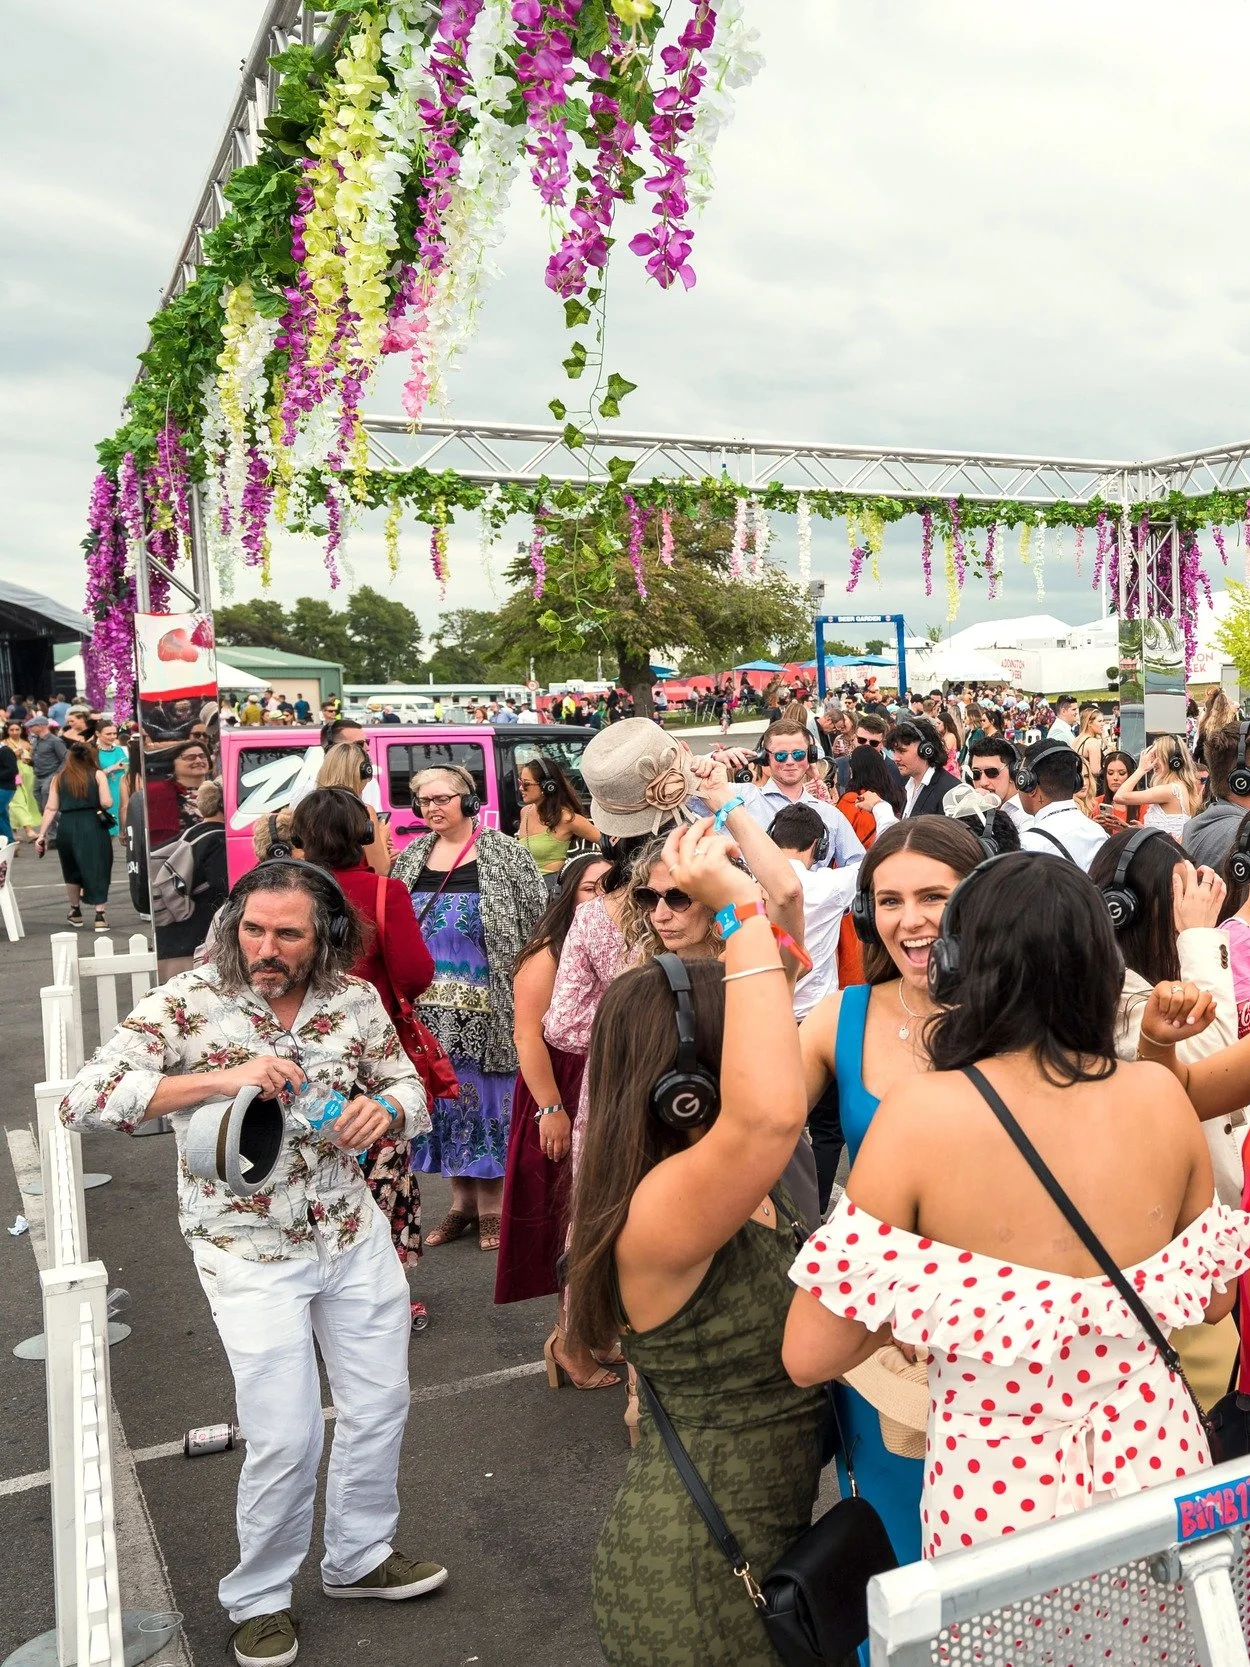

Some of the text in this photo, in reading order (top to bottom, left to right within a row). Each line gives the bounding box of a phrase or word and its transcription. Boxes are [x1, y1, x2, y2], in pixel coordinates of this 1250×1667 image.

[1018, 775, 1024, 785] G
[1235, 777, 1247, 789] G
[274, 848, 284, 857] G
[1234, 862, 1245, 876] G
[1108, 901, 1122, 918] G
[673, 1093, 699, 1117] G
